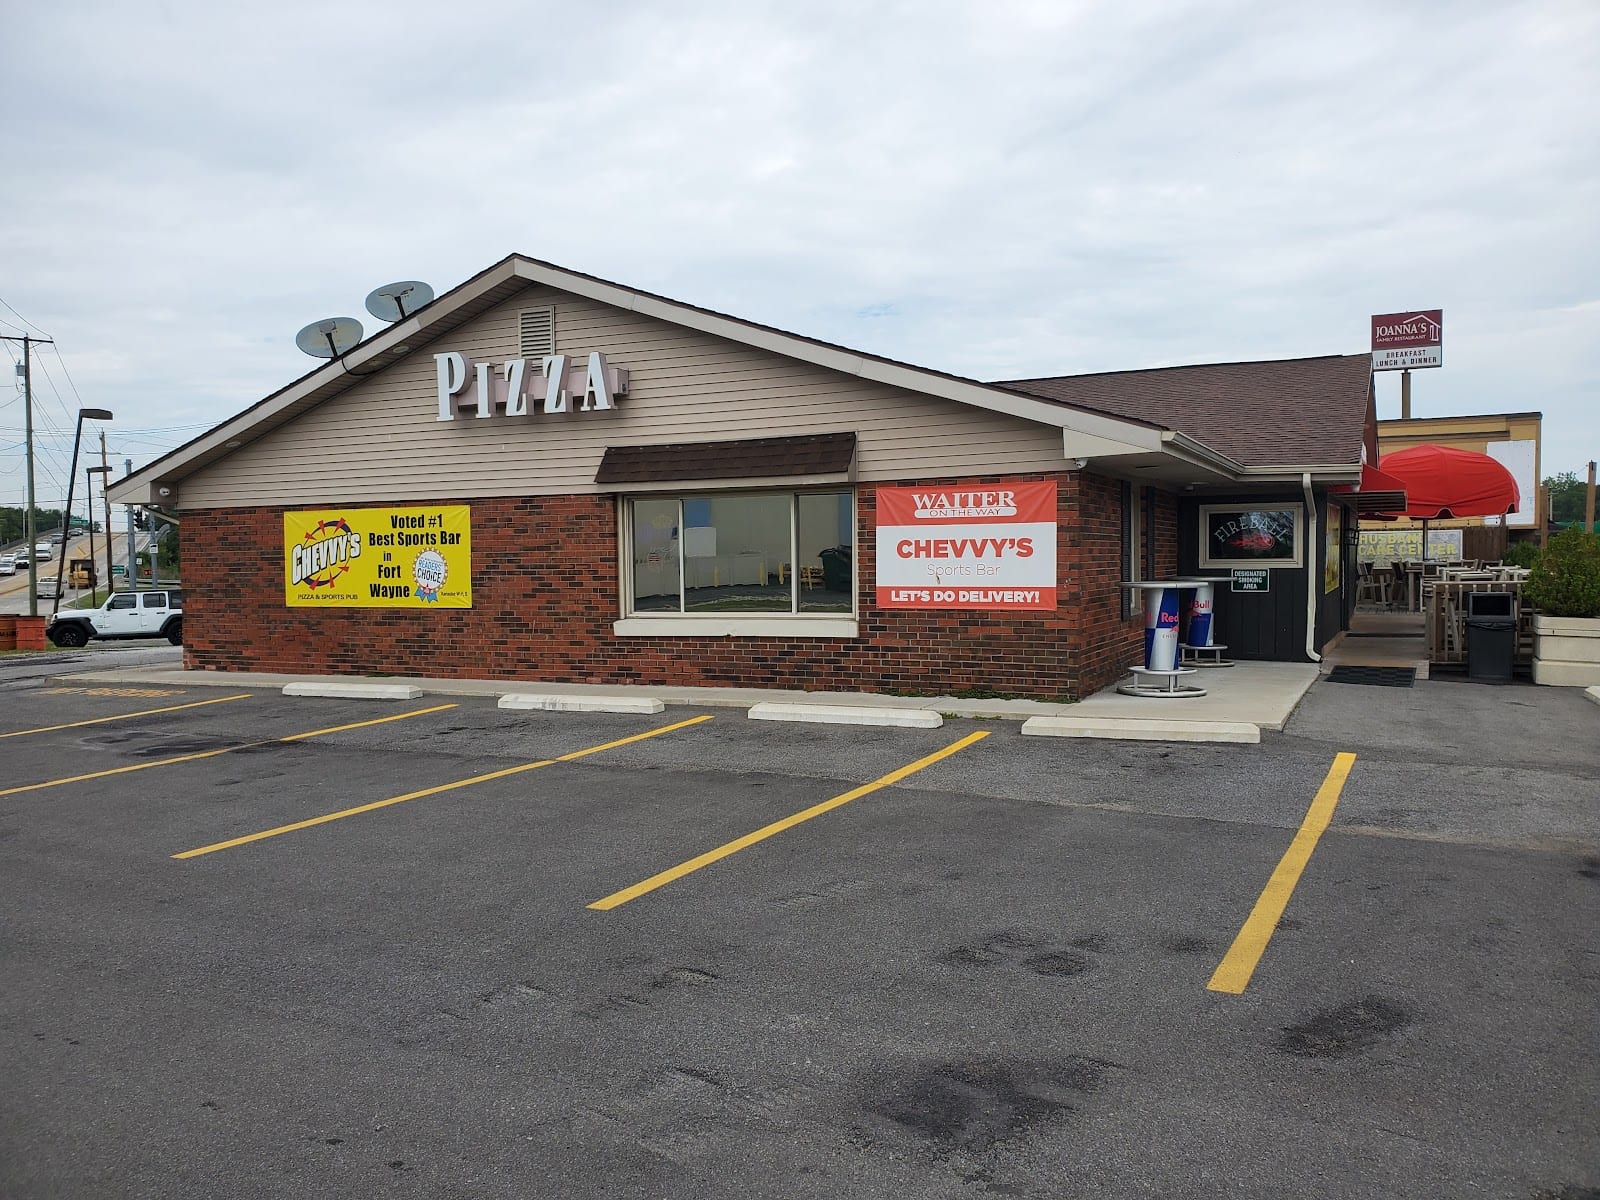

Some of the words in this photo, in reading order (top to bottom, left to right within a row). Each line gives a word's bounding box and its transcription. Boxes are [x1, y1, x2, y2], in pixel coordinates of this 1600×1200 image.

[1376, 322, 1427, 338] JOANNA'S
[1386, 350, 1427, 358] BREAKFAST
[1410, 357, 1437, 365] DINNER
[433, 351, 613, 421] PIZZA
[912, 491, 1017, 509] WAITER
[950, 509, 972, 517] THE
[976, 508, 1001, 516] WAY
[391, 514, 425, 529] Voted
[428, 514, 443, 528] #1
[1214, 515, 1290, 543] FIREBALL
[369, 532, 394, 546] Best
[397, 531, 437, 547] Sports
[440, 530, 461, 545] Bar
[896, 537, 1034, 558] CHEVVY'S
[292, 532, 361, 585] CHEVVY'S
[383, 551, 392, 562] in
[378, 564, 401, 579] Fort
[927, 564, 971, 577] Sports
[976, 563, 1001, 576] Bar
[370, 583, 410, 599] Wayne
[891, 590, 930, 602] LET'S
[934, 591, 956, 602] DO
[959, 591, 1040, 603] DELIVERY!
[1193, 600, 1210, 608] Bull
